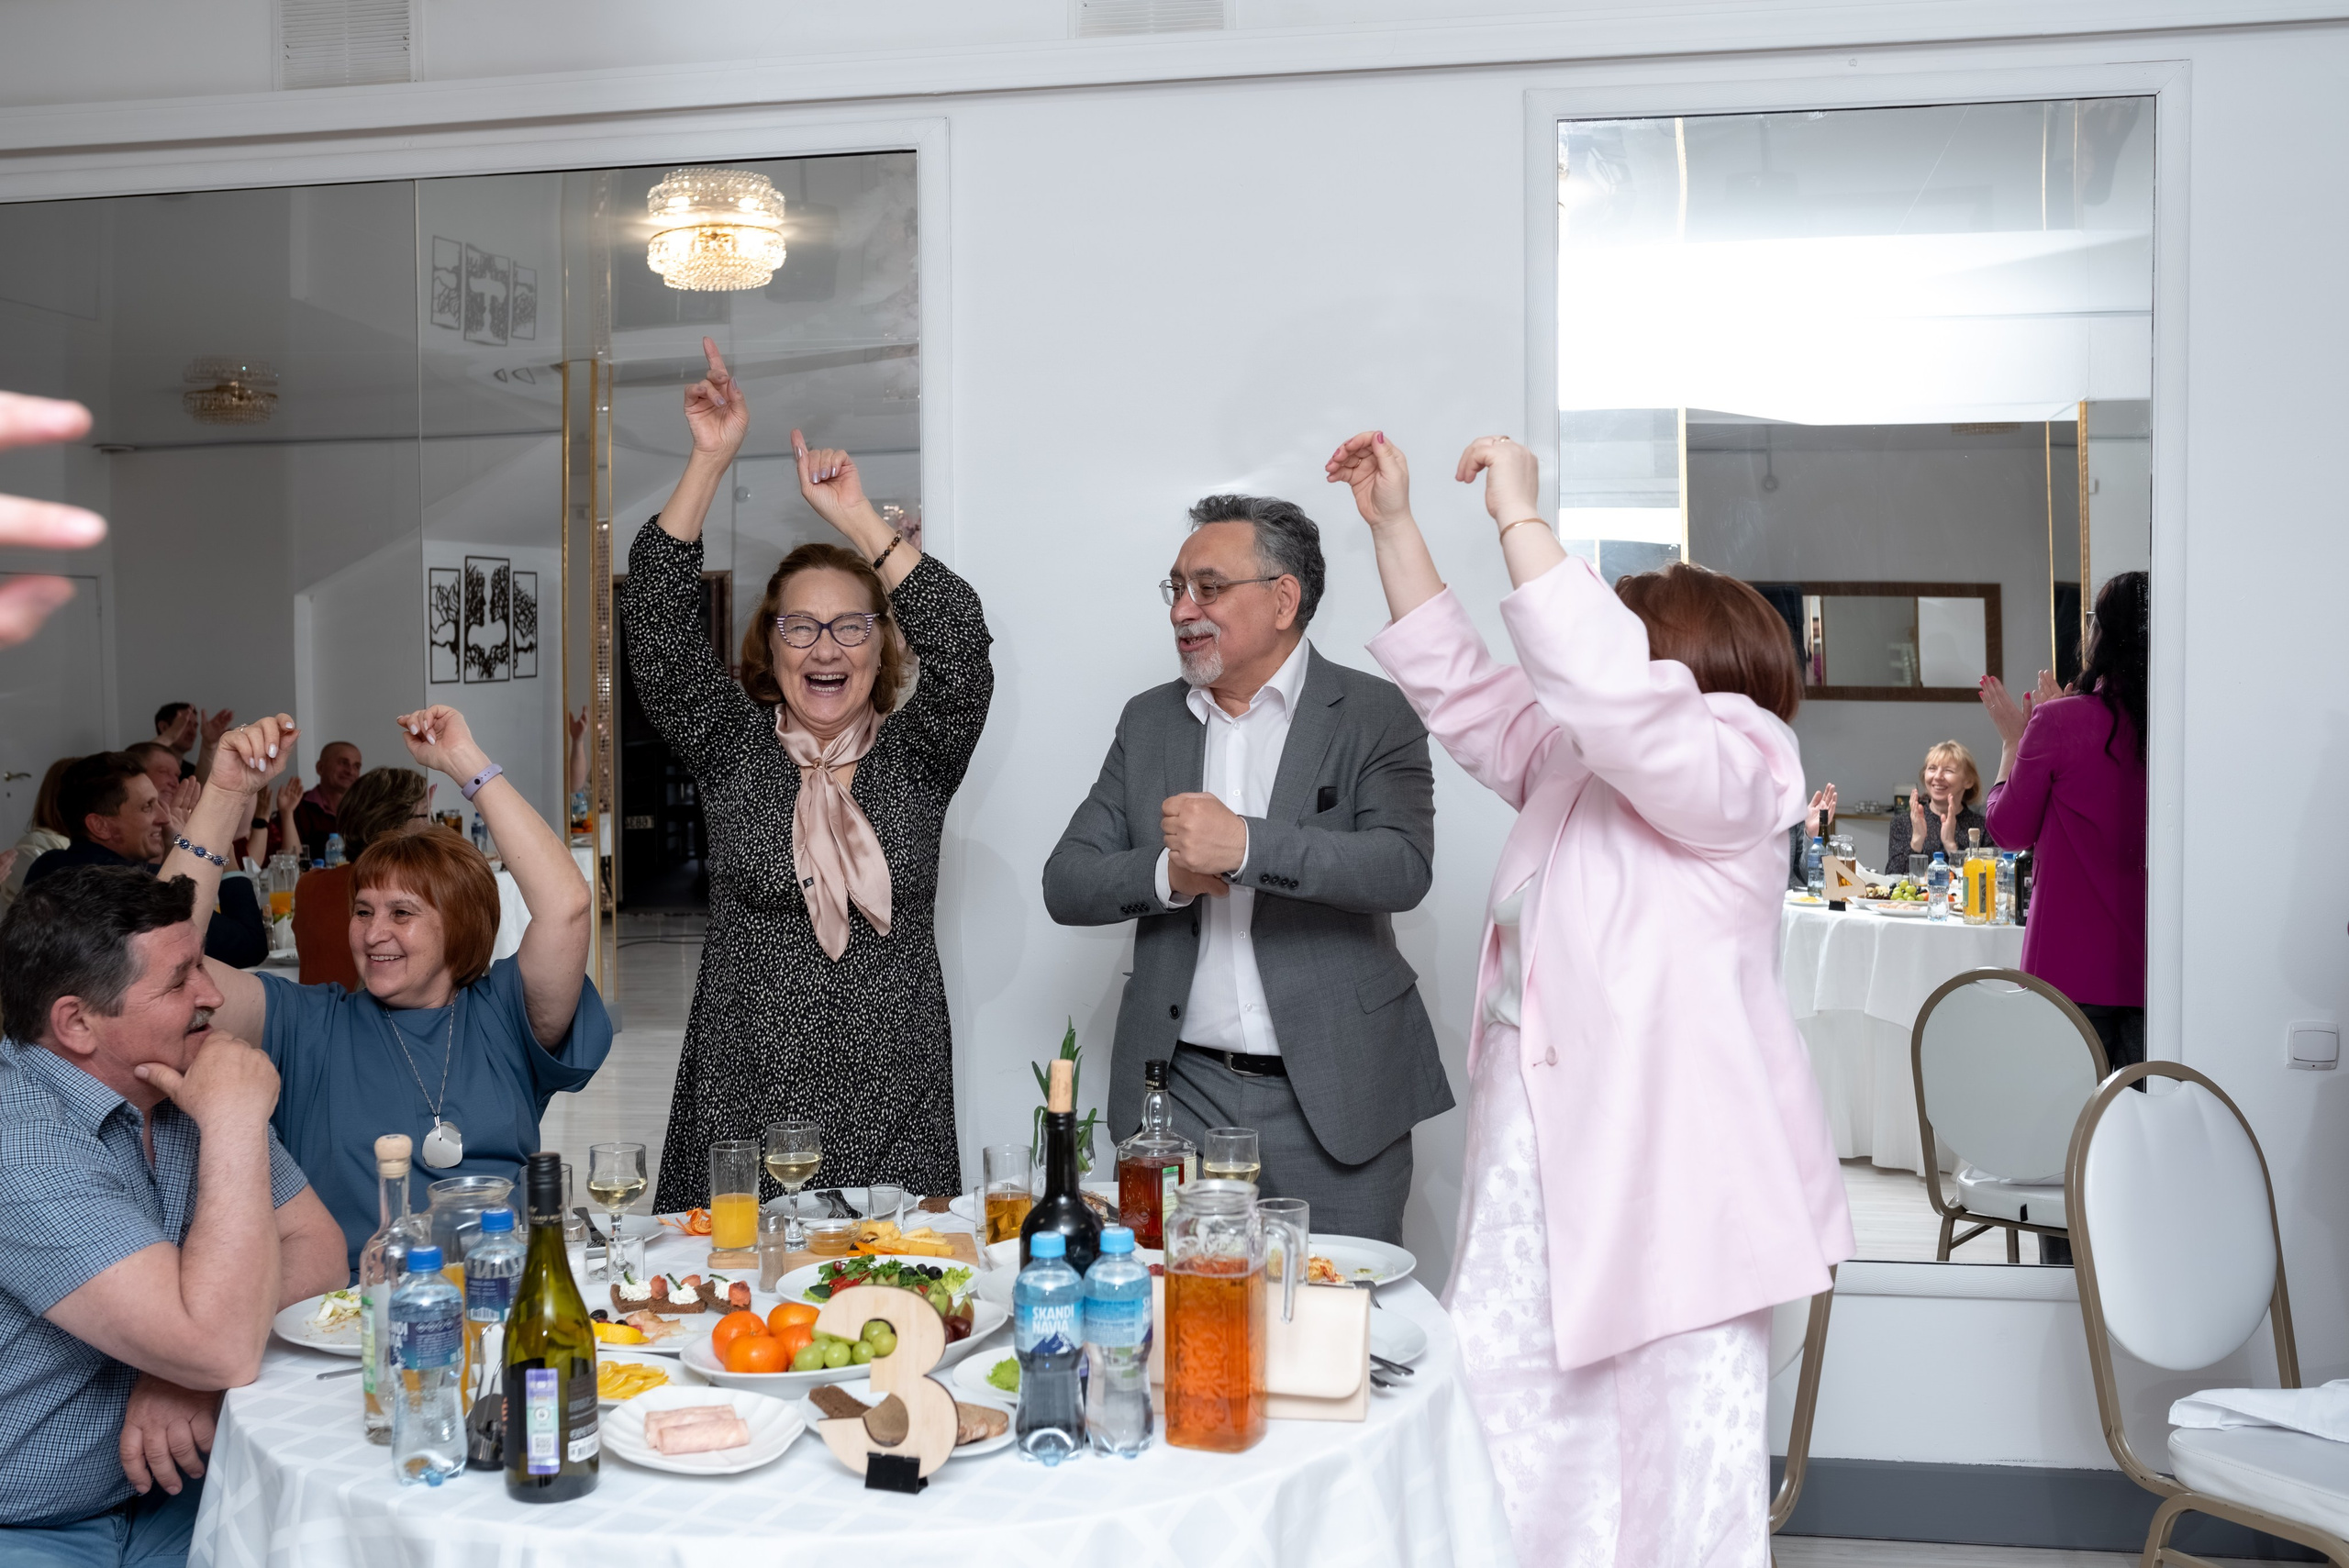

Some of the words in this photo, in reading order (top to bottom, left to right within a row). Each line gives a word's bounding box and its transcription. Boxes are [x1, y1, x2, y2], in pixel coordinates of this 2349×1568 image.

[1032, 1304, 1074, 1321] SKANDI
[1032, 1320, 1070, 1333] NAVIA
[815, 1284, 959, 1479] 3
